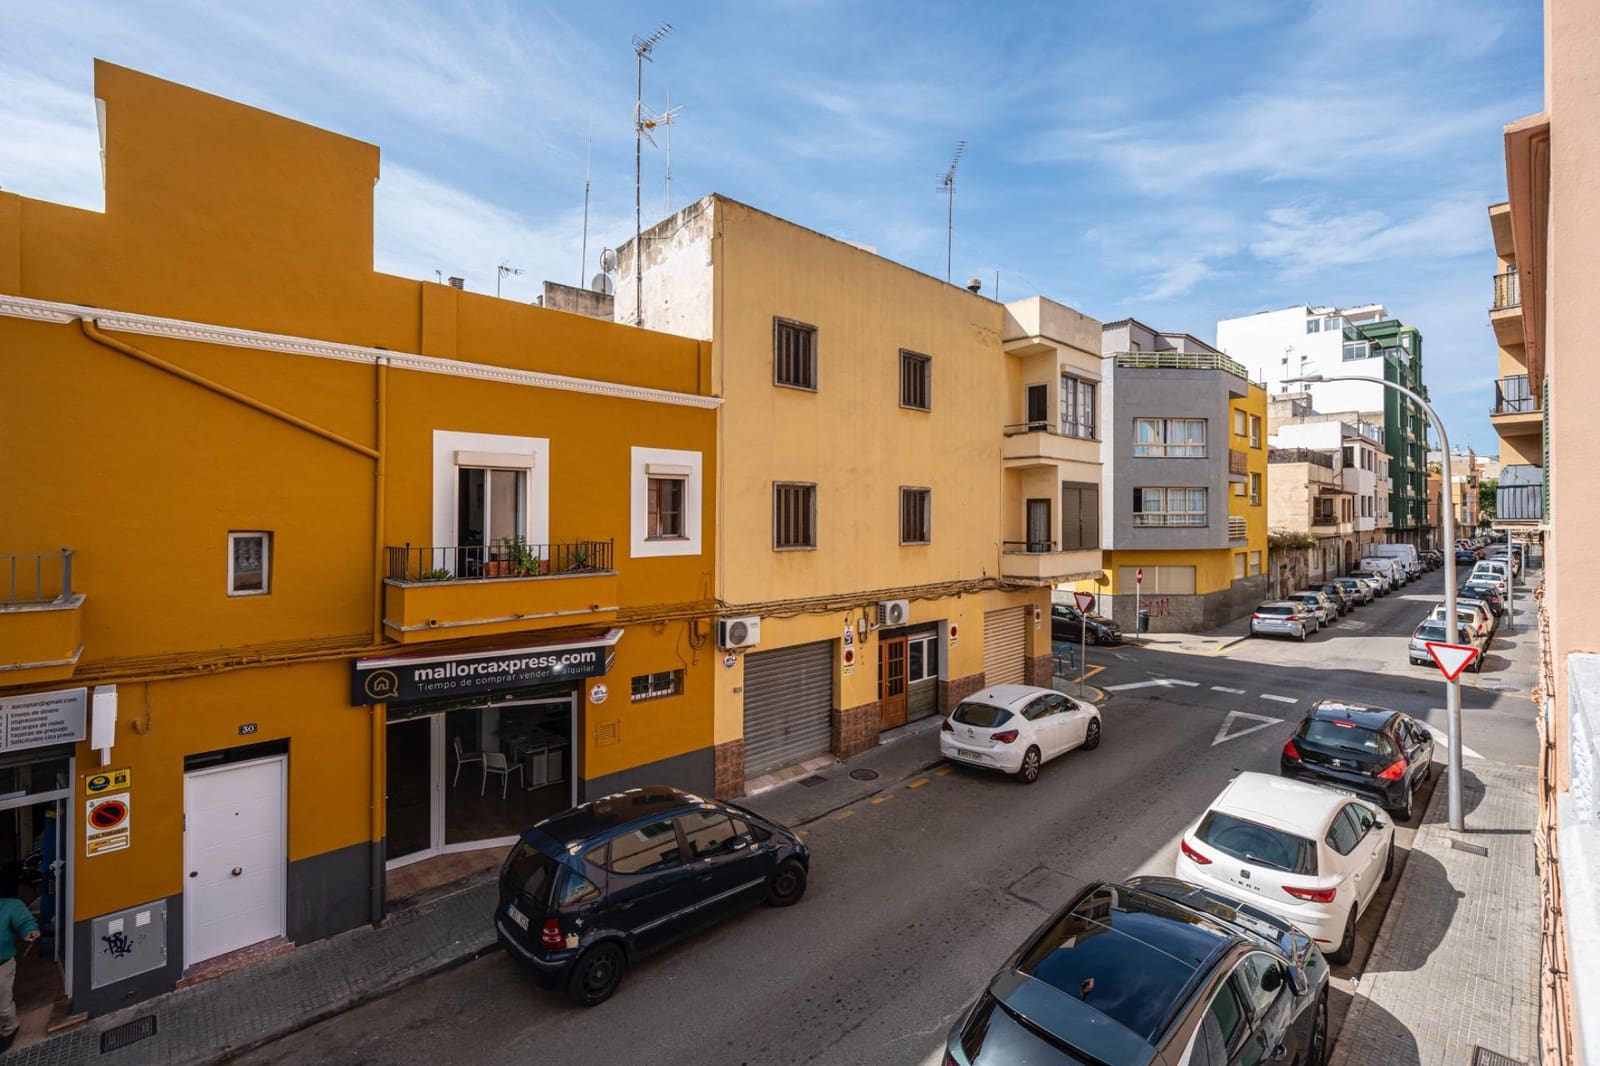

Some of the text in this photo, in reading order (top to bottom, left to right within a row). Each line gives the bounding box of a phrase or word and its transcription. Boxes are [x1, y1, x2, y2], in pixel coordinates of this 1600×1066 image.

[414, 651, 596, 681] mallorcaxpress.com
[417, 680, 457, 691] Tiempo
[460, 678, 472, 687] de
[475, 673, 516, 685] comprar
[519, 669, 550, 679] vender
[241, 725, 255, 734] 30
